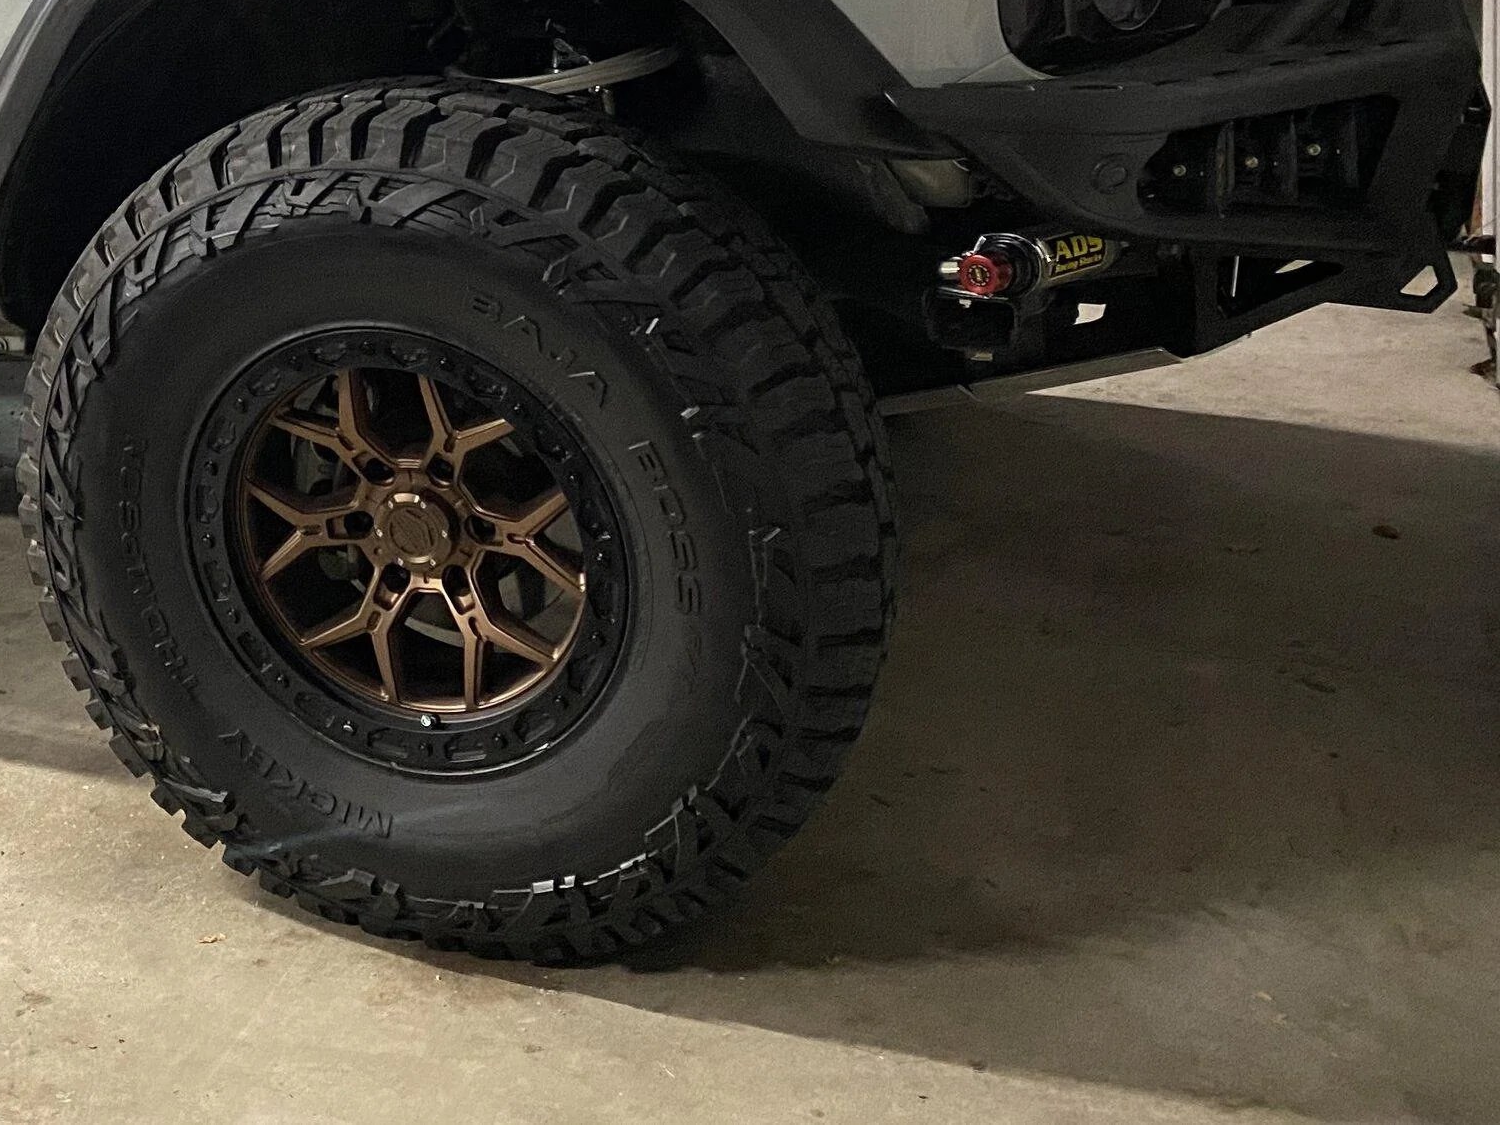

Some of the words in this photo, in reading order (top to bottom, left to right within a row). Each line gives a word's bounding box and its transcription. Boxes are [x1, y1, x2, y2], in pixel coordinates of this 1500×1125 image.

[1056, 235, 1103, 262] ADS
[466, 286, 609, 409] BAJA
[627, 439, 702, 617] BOSS
